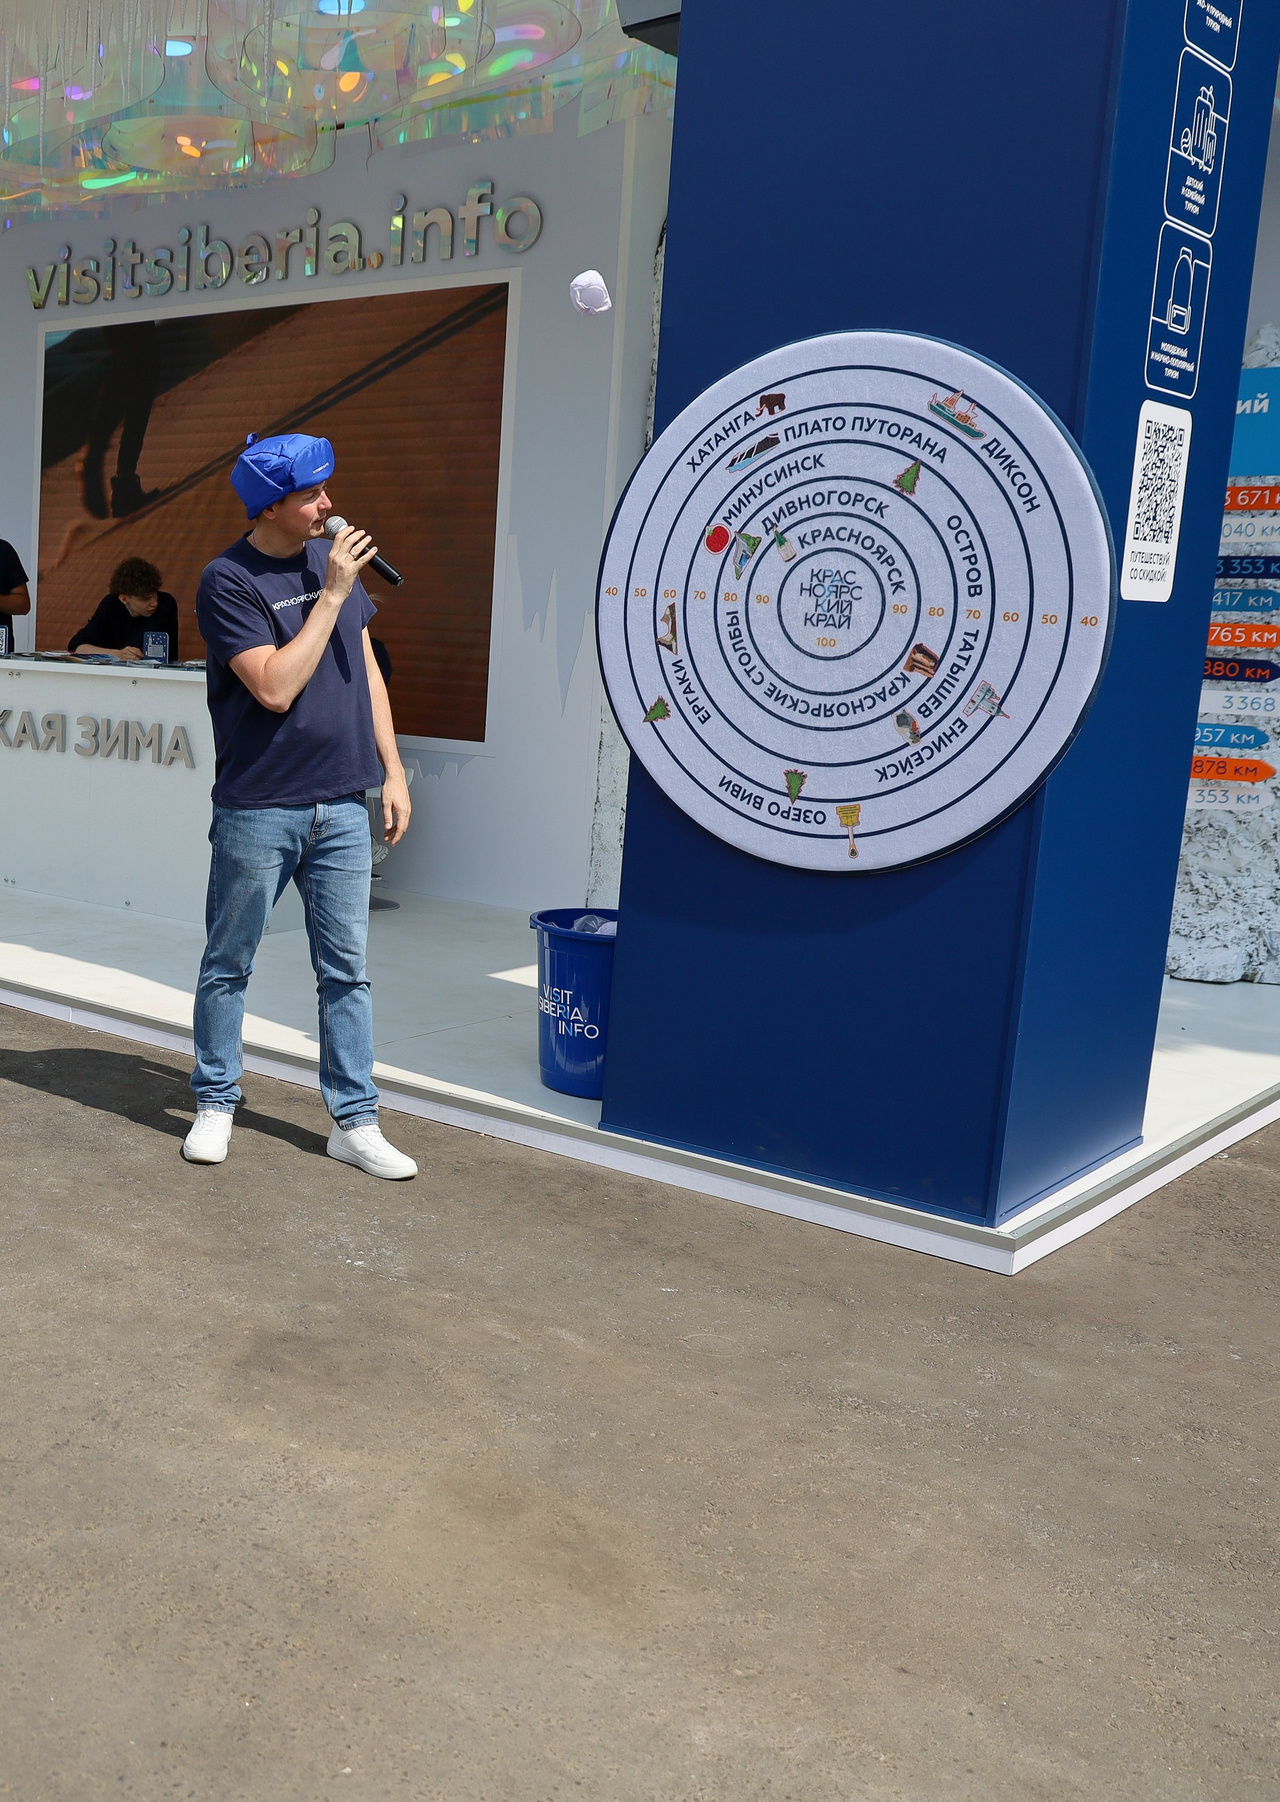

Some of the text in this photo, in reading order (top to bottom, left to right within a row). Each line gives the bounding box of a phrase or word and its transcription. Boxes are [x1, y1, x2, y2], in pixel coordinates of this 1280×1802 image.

[25, 180, 543, 310] visitsiberia.info
[686, 410, 756, 473] ХАТАНГА
[783, 416, 948, 464] ПЛАТО ПУТОРАНА
[980, 437, 1041, 514] ДИКСОН
[722, 453, 825, 527] МИНУСИНСК
[1237, 489, 1271, 506] 671
[761, 490, 890, 536] ДИВНОГОРСК
[797, 526, 907, 595] КРАСНОЯРСК
[1130, 551, 1170, 565] ПУТЕШЕСТВУЙ
[1130, 568, 1138, 580] СО
[1229, 559, 1265, 575] 353
[810, 568, 857, 585] КРАС
[605, 587, 618, 596] 40
[634, 588, 647, 597] 50
[663, 589, 677, 598] 60
[693, 590, 707, 600] 70
[723, 592, 738, 602] 80
[755, 594, 770, 604] 90
[800, 582, 863, 601] НОЯРС
[1212, 591, 1243, 606] 417
[815, 598, 853, 615] КИЙ
[892, 604, 908, 615] 90
[928, 606, 945, 617] 80
[965, 609, 981, 620] 70
[804, 612, 851, 630] КРАЙ
[916, 514, 983, 719] ОСТРОВ ТАТЫШЕВ
[1002, 611, 1019, 623] 60
[1041, 614, 1058, 625] 50
[1080, 616, 1098, 627] 40
[816, 636, 836, 648] 100
[1209, 626, 1246, 643] 765
[726, 610, 911, 718] КРАСНОЯРСКИЕ СТОЛБЫ
[671, 658, 712, 725] ЕРГАКИ
[73, 715, 195, 769] ЗИМА
[874, 716, 969, 783] ЕНИСЕЙСК
[1192, 760, 1228, 775] 878
[718, 775, 827, 825] ОЗЕРО ВИВИ
[1194, 789, 1230, 804] 353
[543, 983, 573, 1005] VISIT
[538, 995, 588, 1023] SIBERIA.
[558, 1020, 600, 1039] INFO
